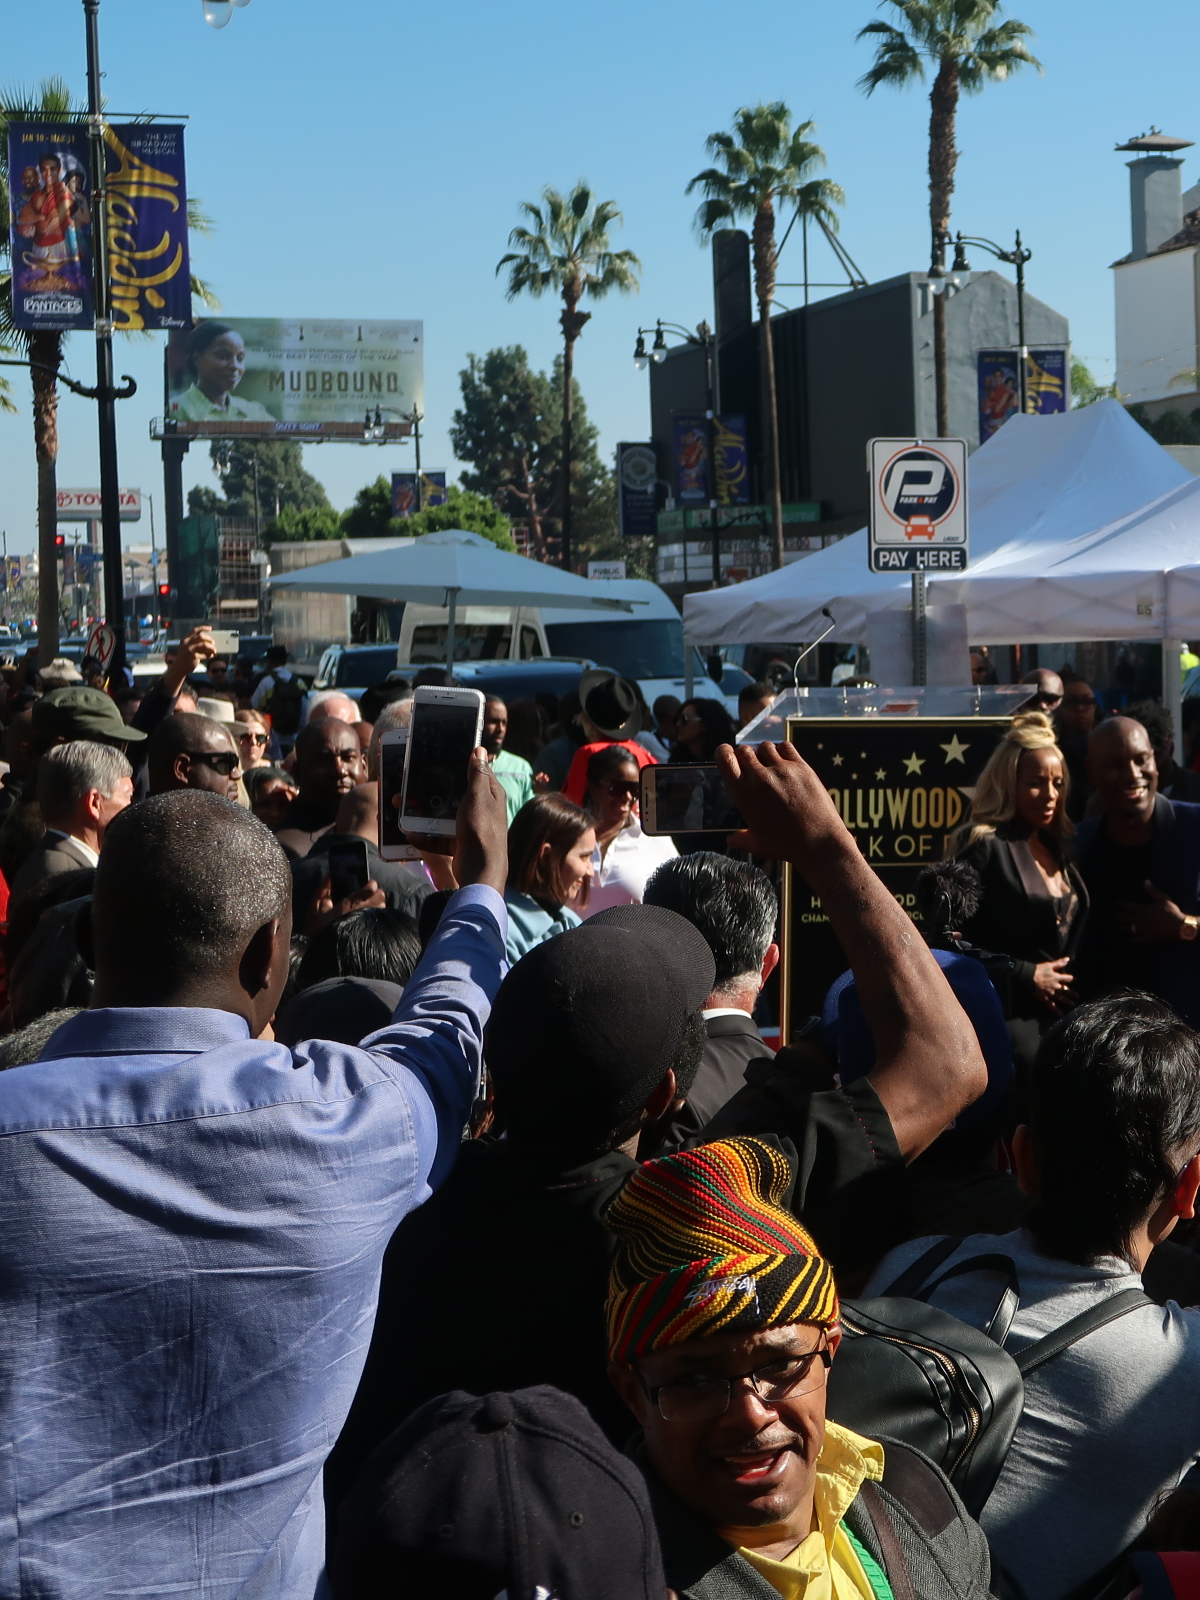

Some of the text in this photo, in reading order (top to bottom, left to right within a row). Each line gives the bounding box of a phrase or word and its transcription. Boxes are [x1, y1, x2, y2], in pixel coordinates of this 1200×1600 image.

[22, 133, 34, 144] JAN
[268, 370, 399, 392] MUDBOUND
[75, 493, 138, 506] TOYTA
[879, 550, 961, 567] PAY HERE
[894, 834, 932, 858] OF
